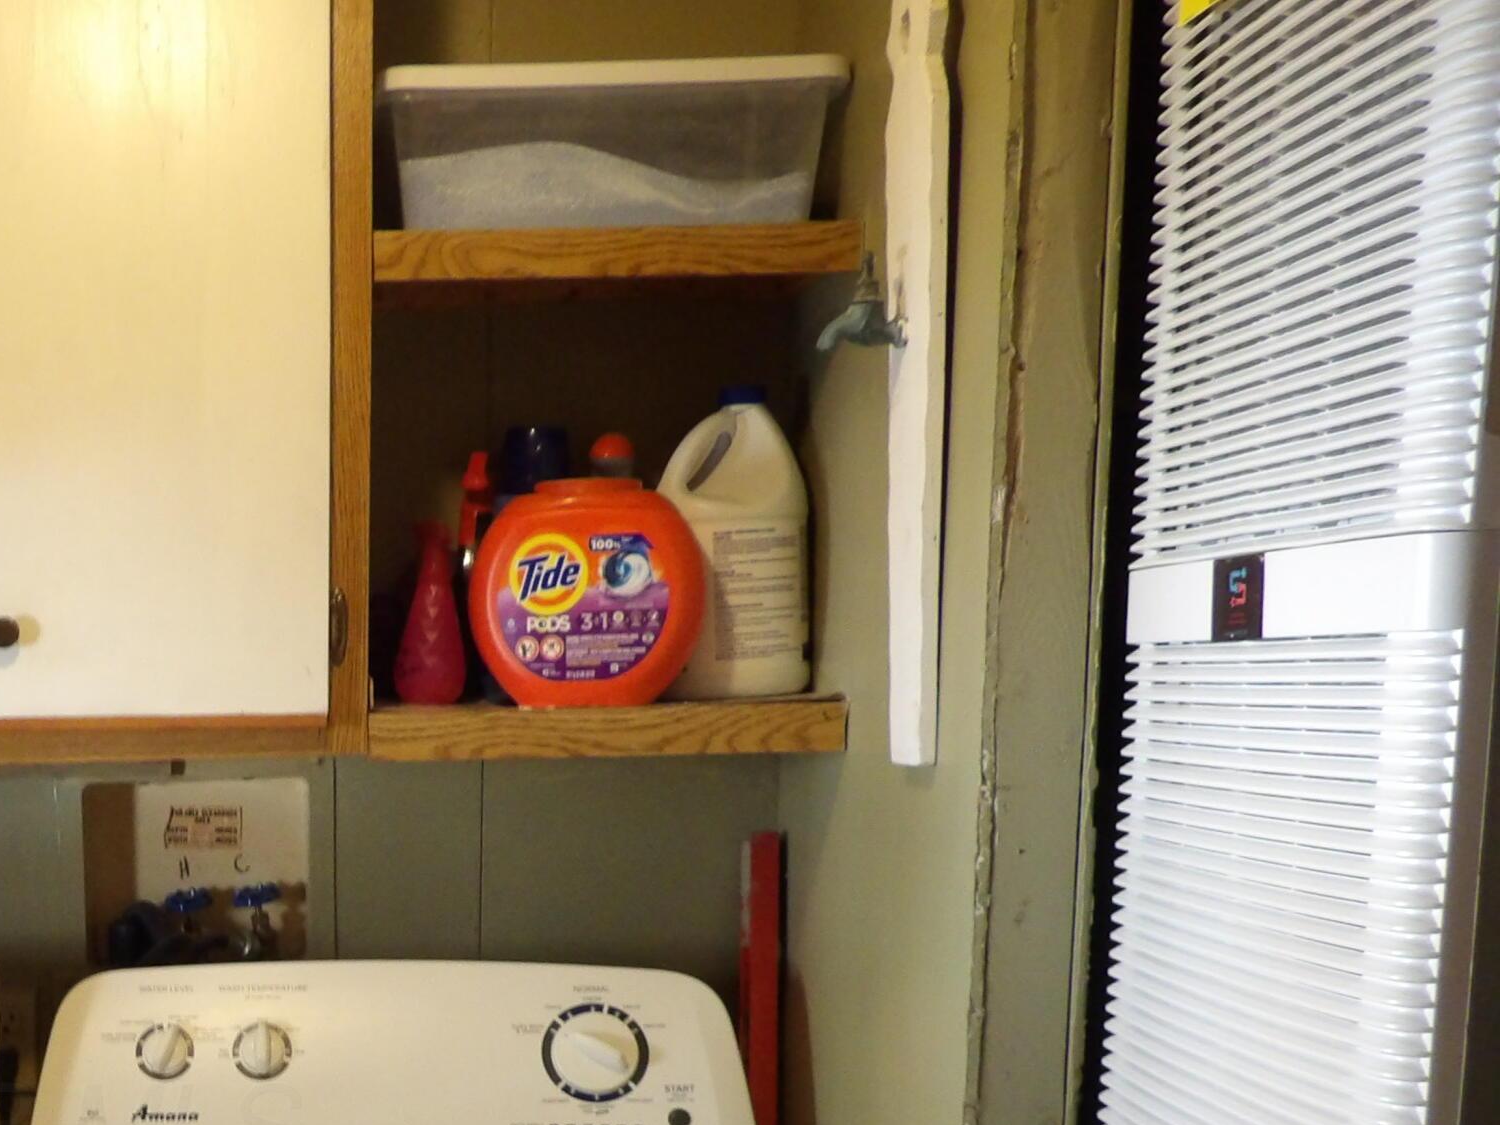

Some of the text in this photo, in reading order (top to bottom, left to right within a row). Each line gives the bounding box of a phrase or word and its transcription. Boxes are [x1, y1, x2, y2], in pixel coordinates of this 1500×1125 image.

[517, 553, 581, 602] Tide
[526, 611, 609, 634] PODS 3 1
[664, 1084, 695, 1093] START
[131, 1103, 199, 1123] Amana
